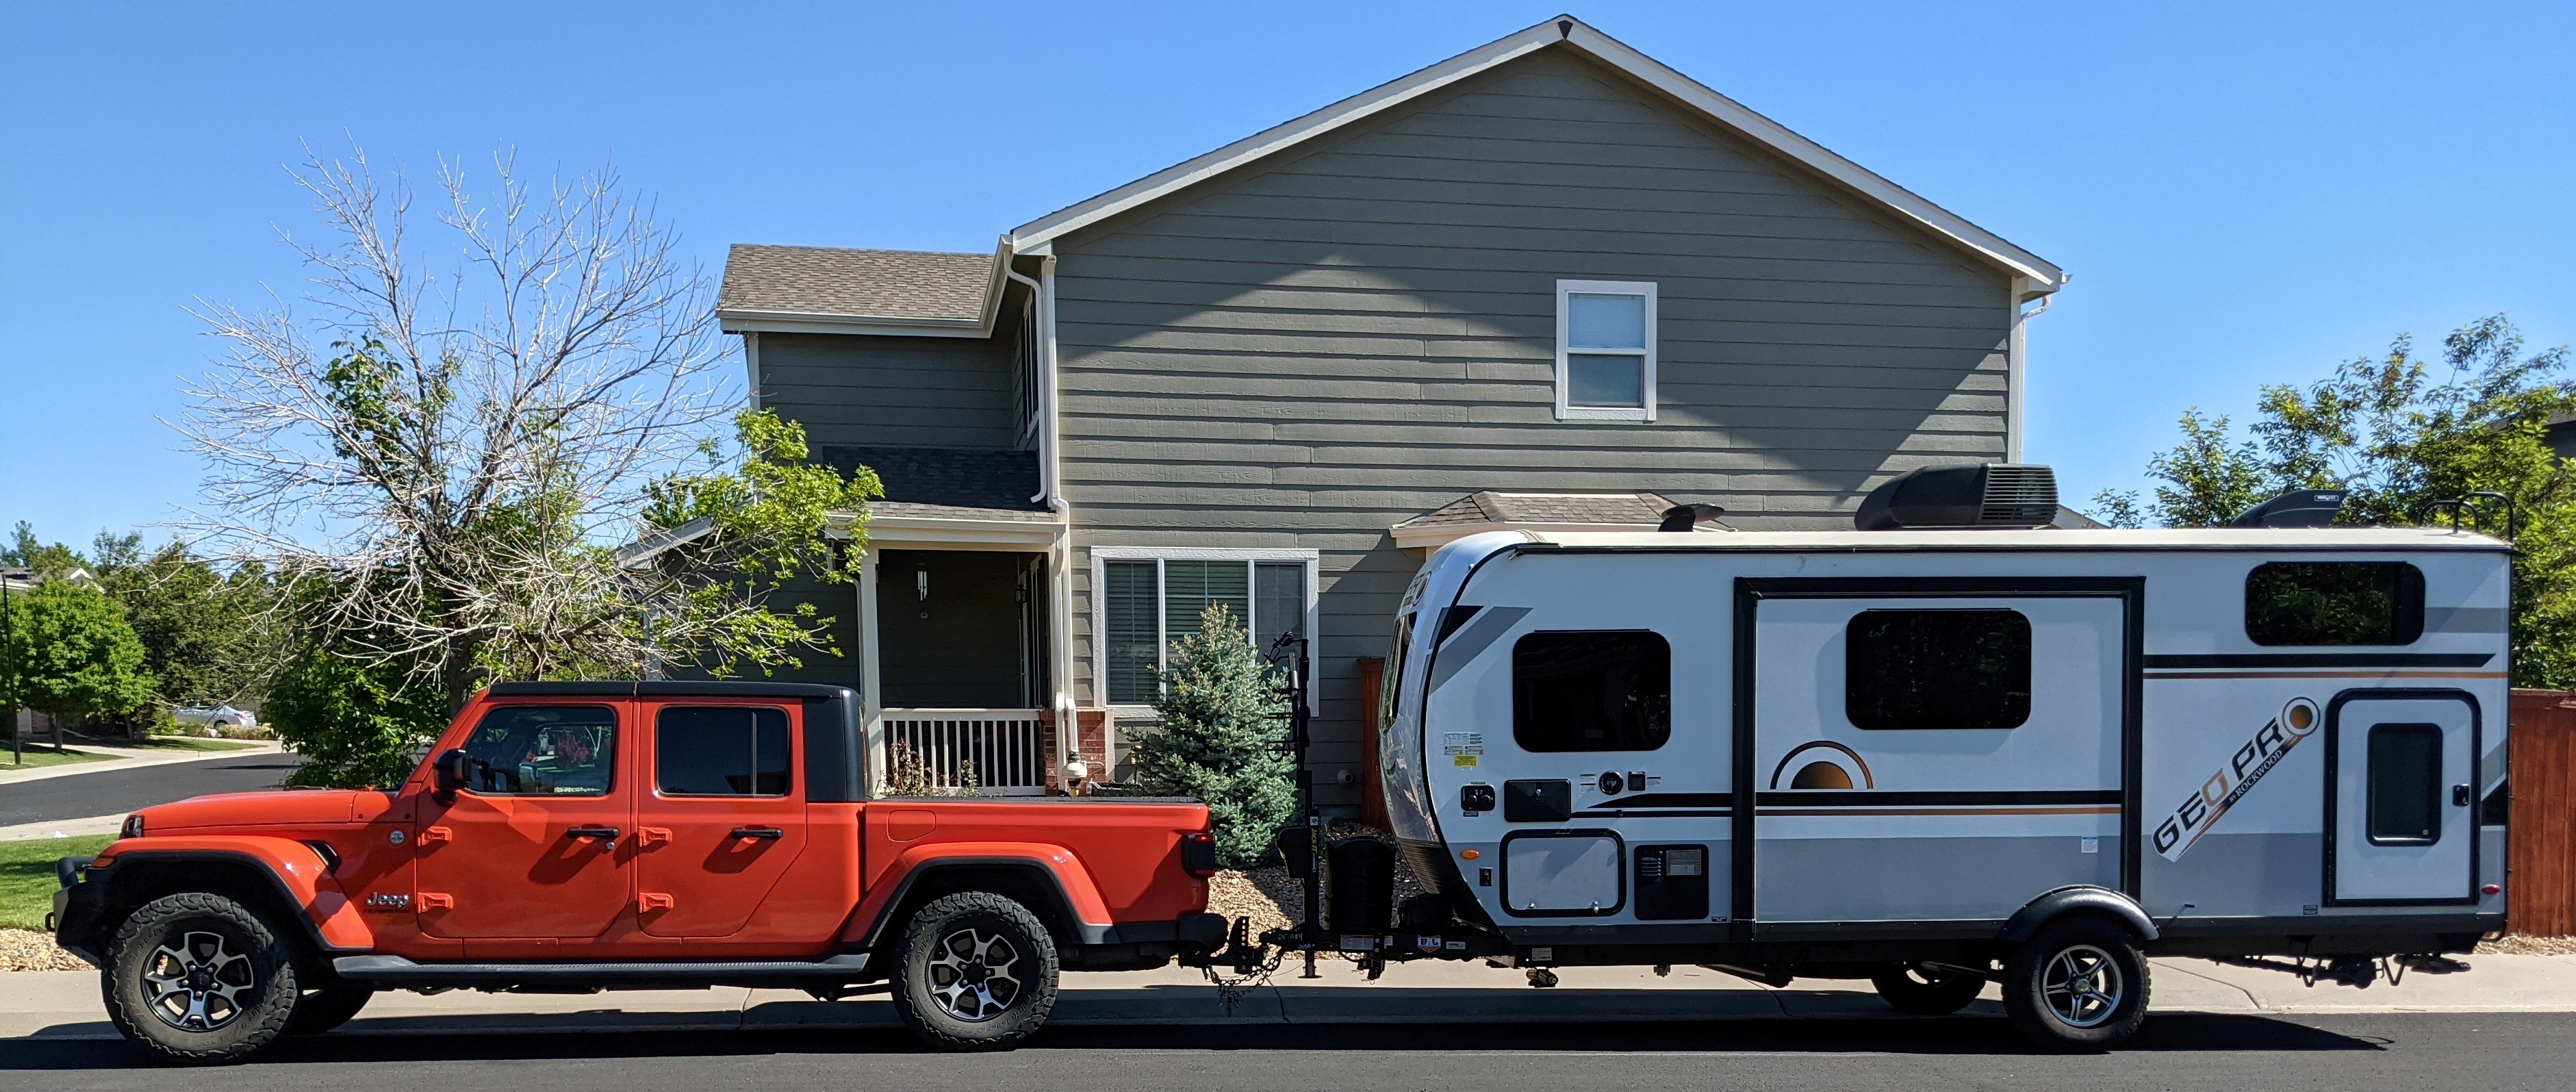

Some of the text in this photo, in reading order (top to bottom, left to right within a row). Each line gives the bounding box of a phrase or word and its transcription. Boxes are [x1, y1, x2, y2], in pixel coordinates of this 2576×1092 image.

[2235, 750, 2282, 797] ROCKWOOD
[2153, 767, 2229, 854] GEO
[366, 891, 409, 907] Jeep
